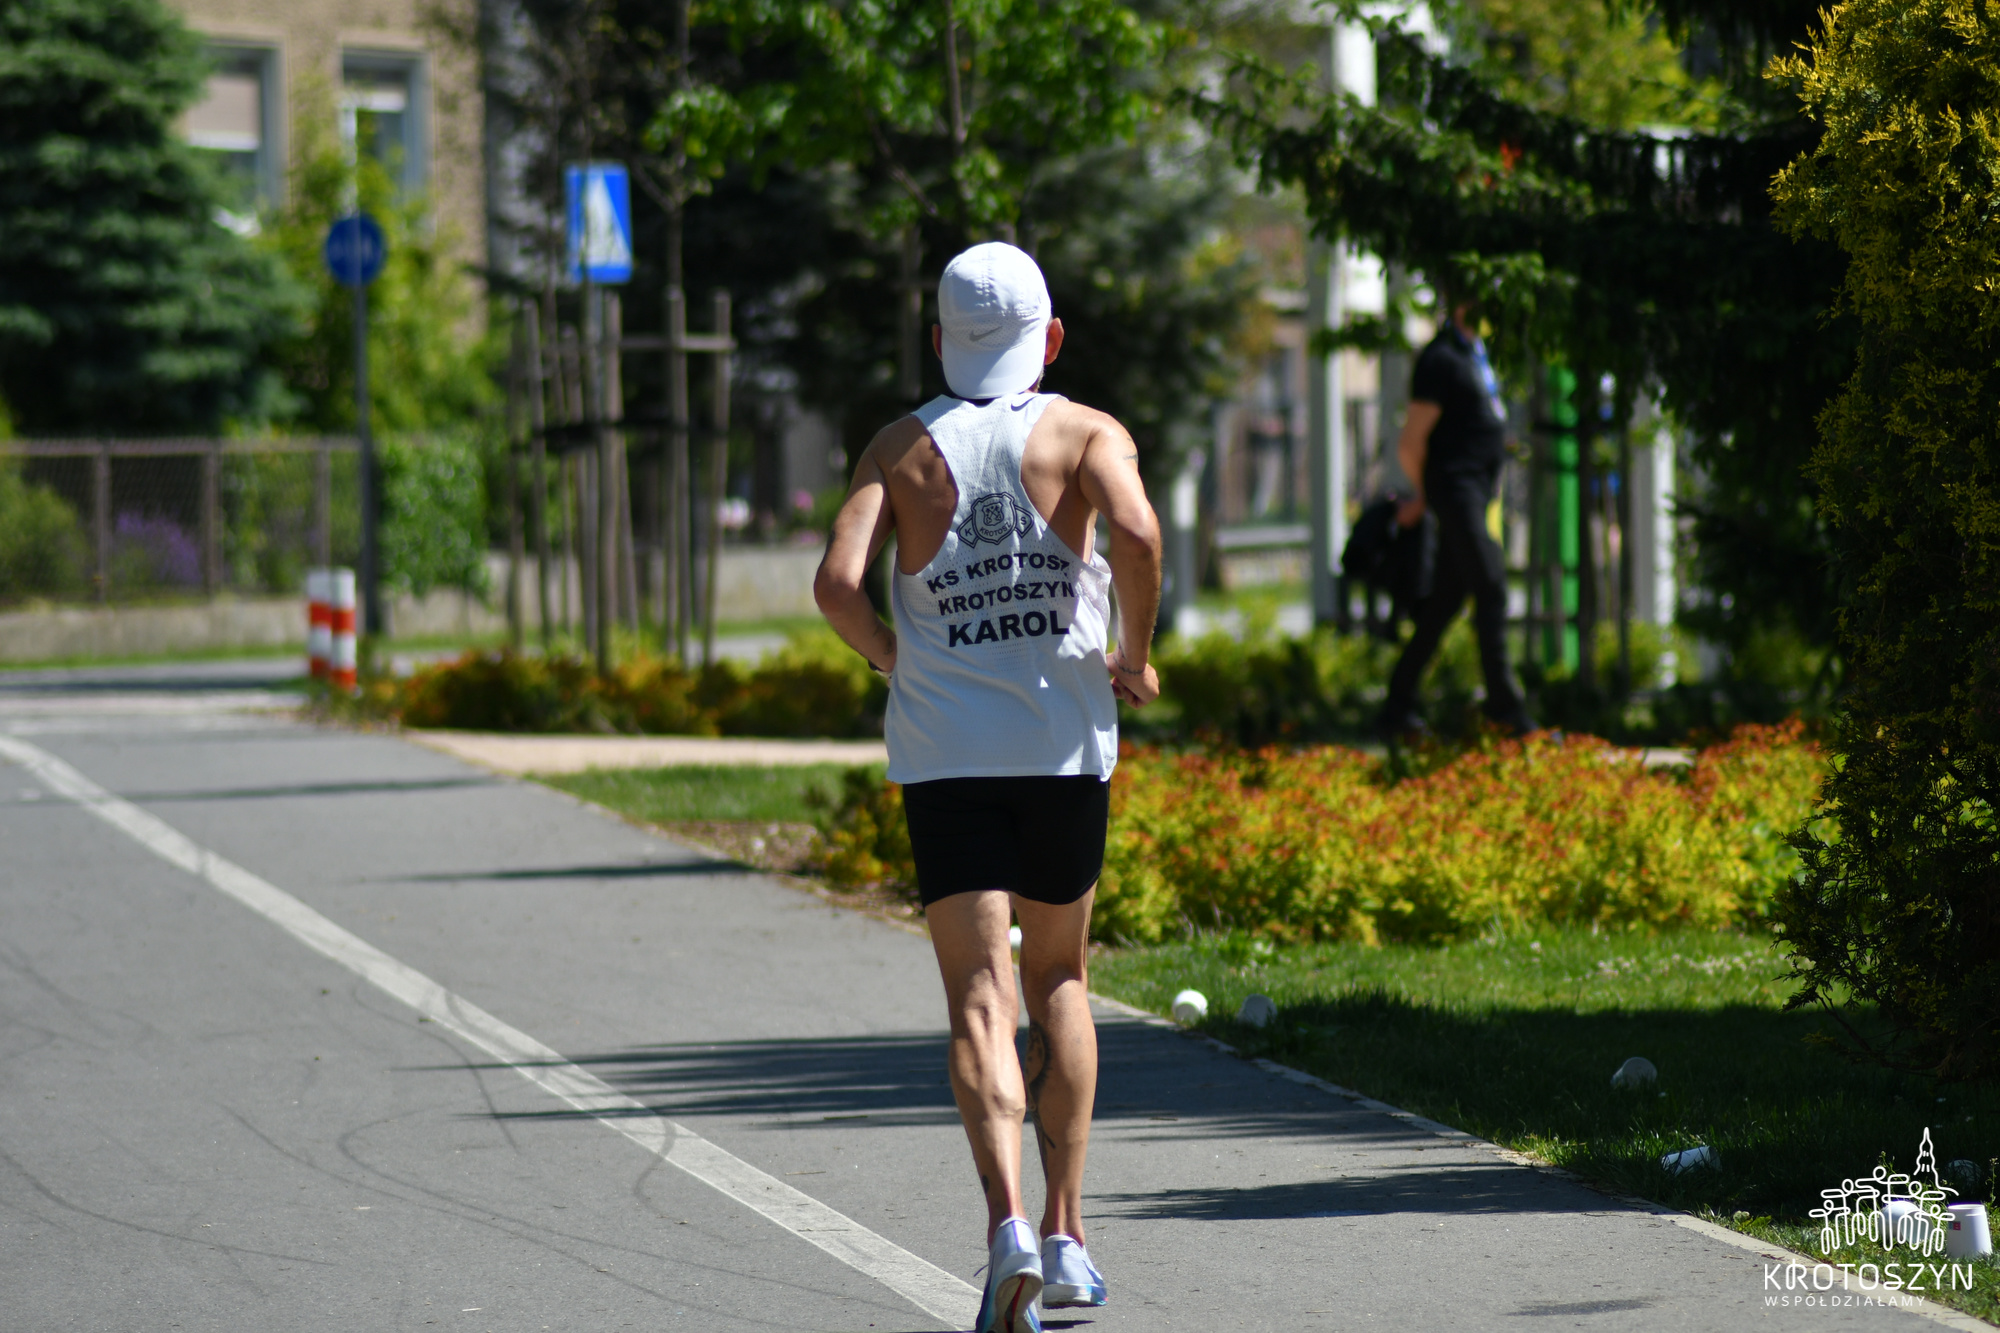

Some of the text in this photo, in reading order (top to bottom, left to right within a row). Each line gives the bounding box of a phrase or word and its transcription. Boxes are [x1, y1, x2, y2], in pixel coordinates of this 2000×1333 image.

[980, 521, 1011, 537] KROTOSZ
[1020, 516, 1027, 525] S
[964, 528, 973, 537] K
[926, 570, 960, 594] KS
[938, 581, 1075, 616] KROTOSZYN
[948, 610, 1070, 647] KAROL
